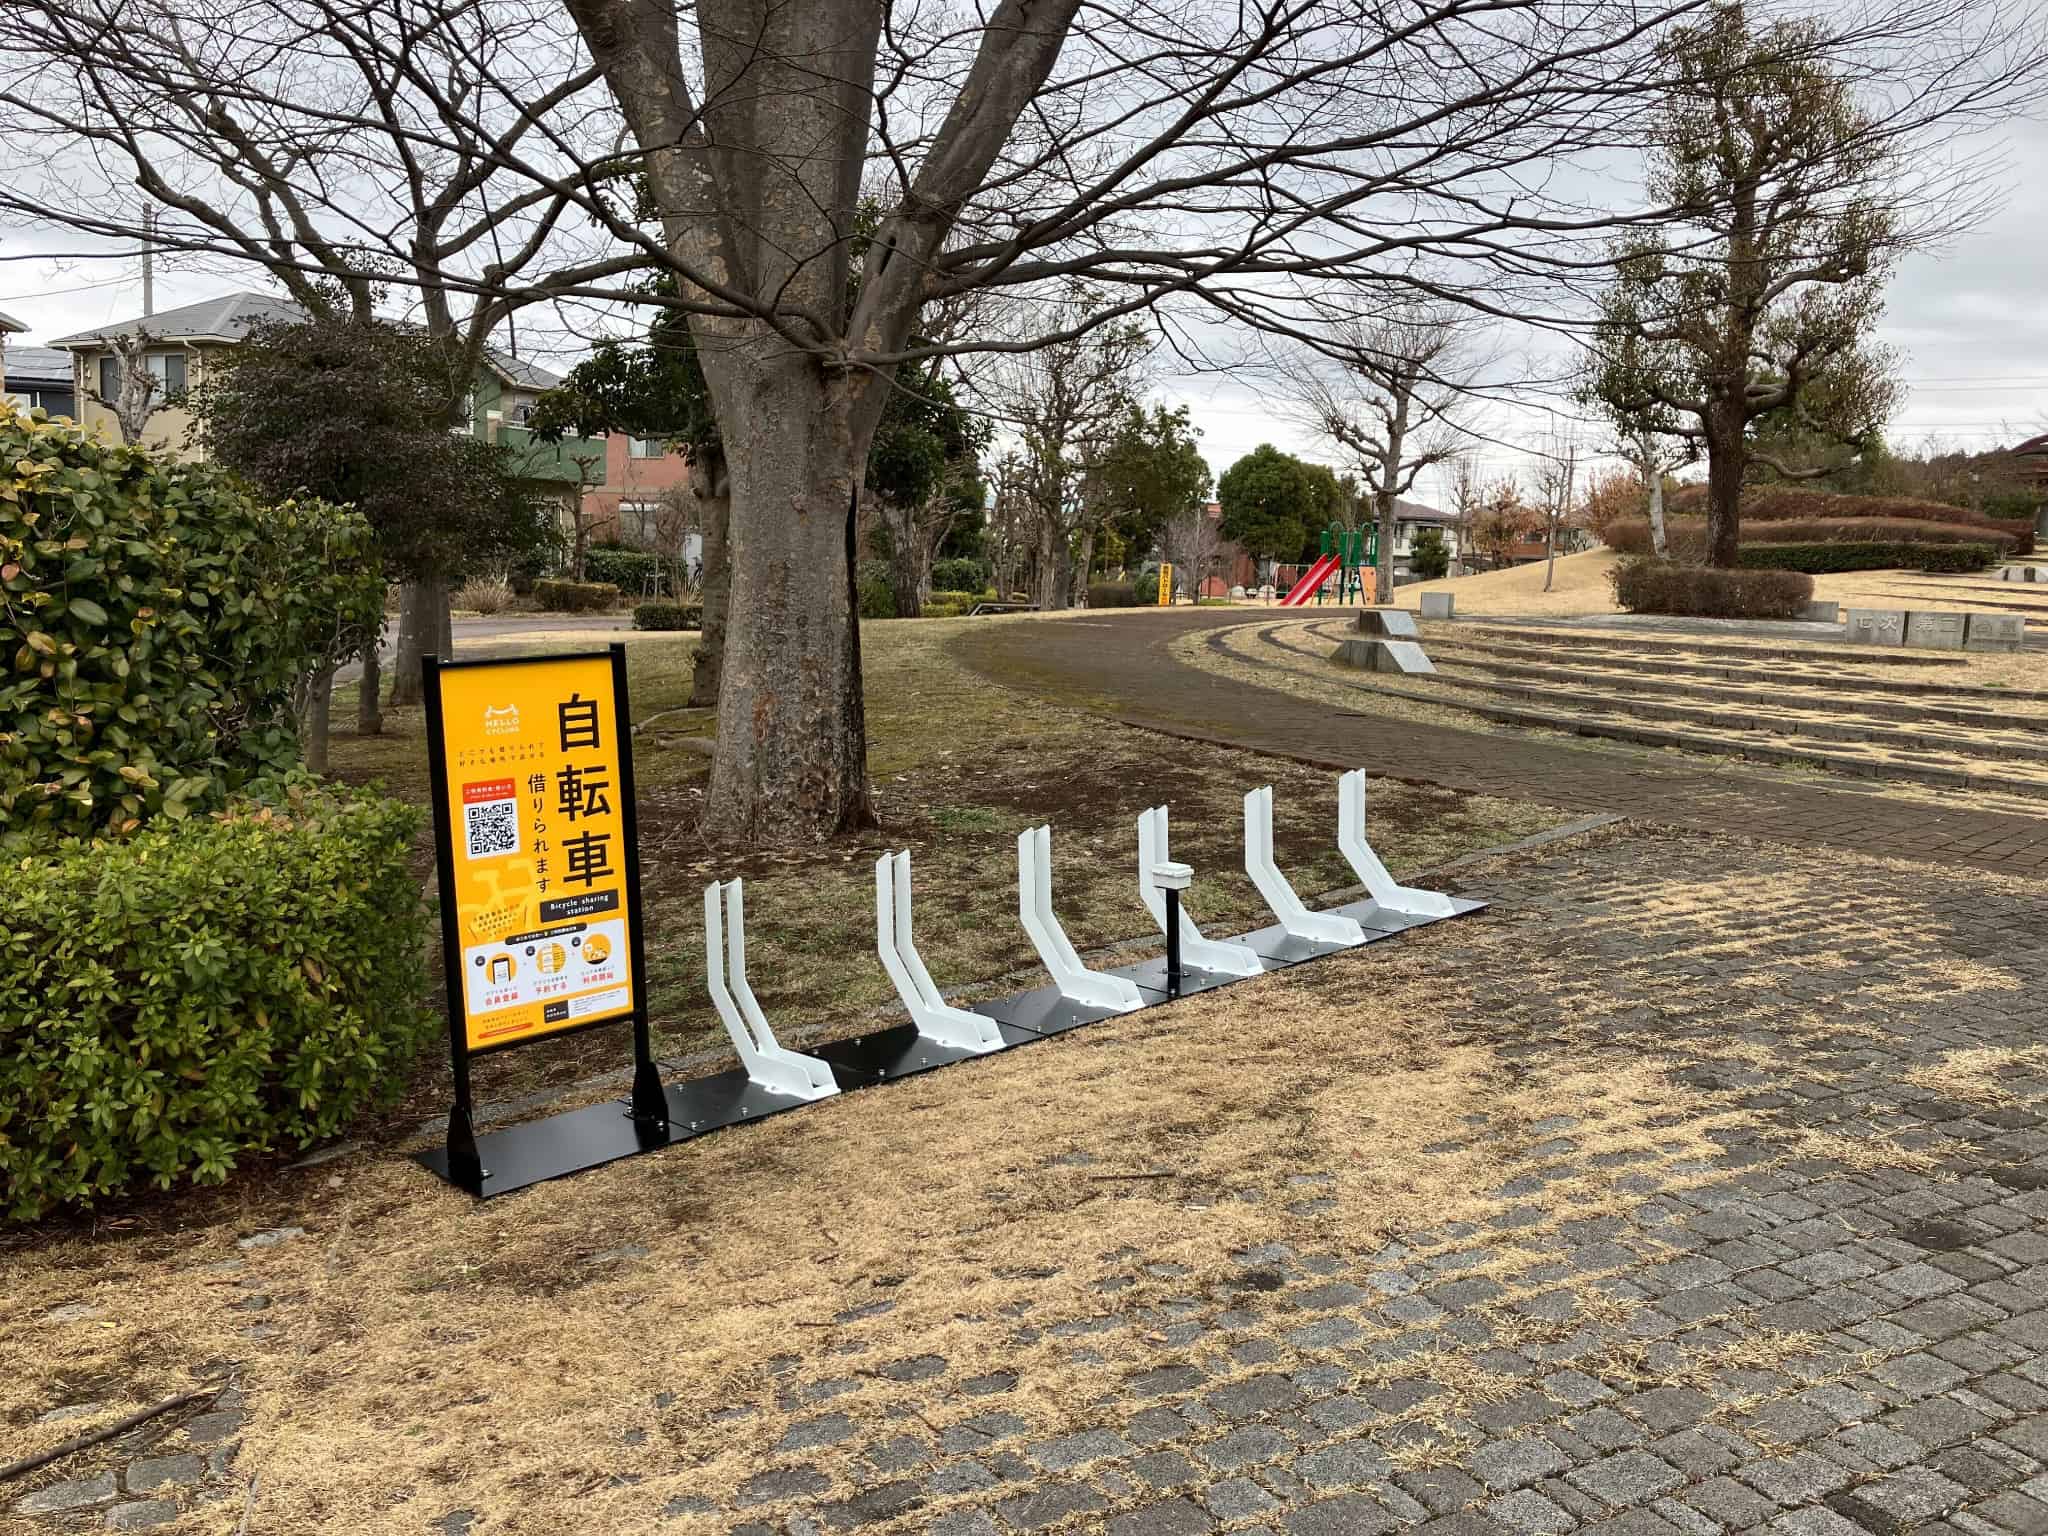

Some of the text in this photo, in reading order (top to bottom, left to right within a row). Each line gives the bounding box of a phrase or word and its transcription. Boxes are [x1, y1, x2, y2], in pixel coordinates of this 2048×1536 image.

[485, 718, 519, 729] HELLO
[555, 692, 615, 889] 自転車
[527, 772, 551, 894] 借りられます
[550, 894, 609, 911] Bicycle sharing
[566, 904, 594, 916] station
